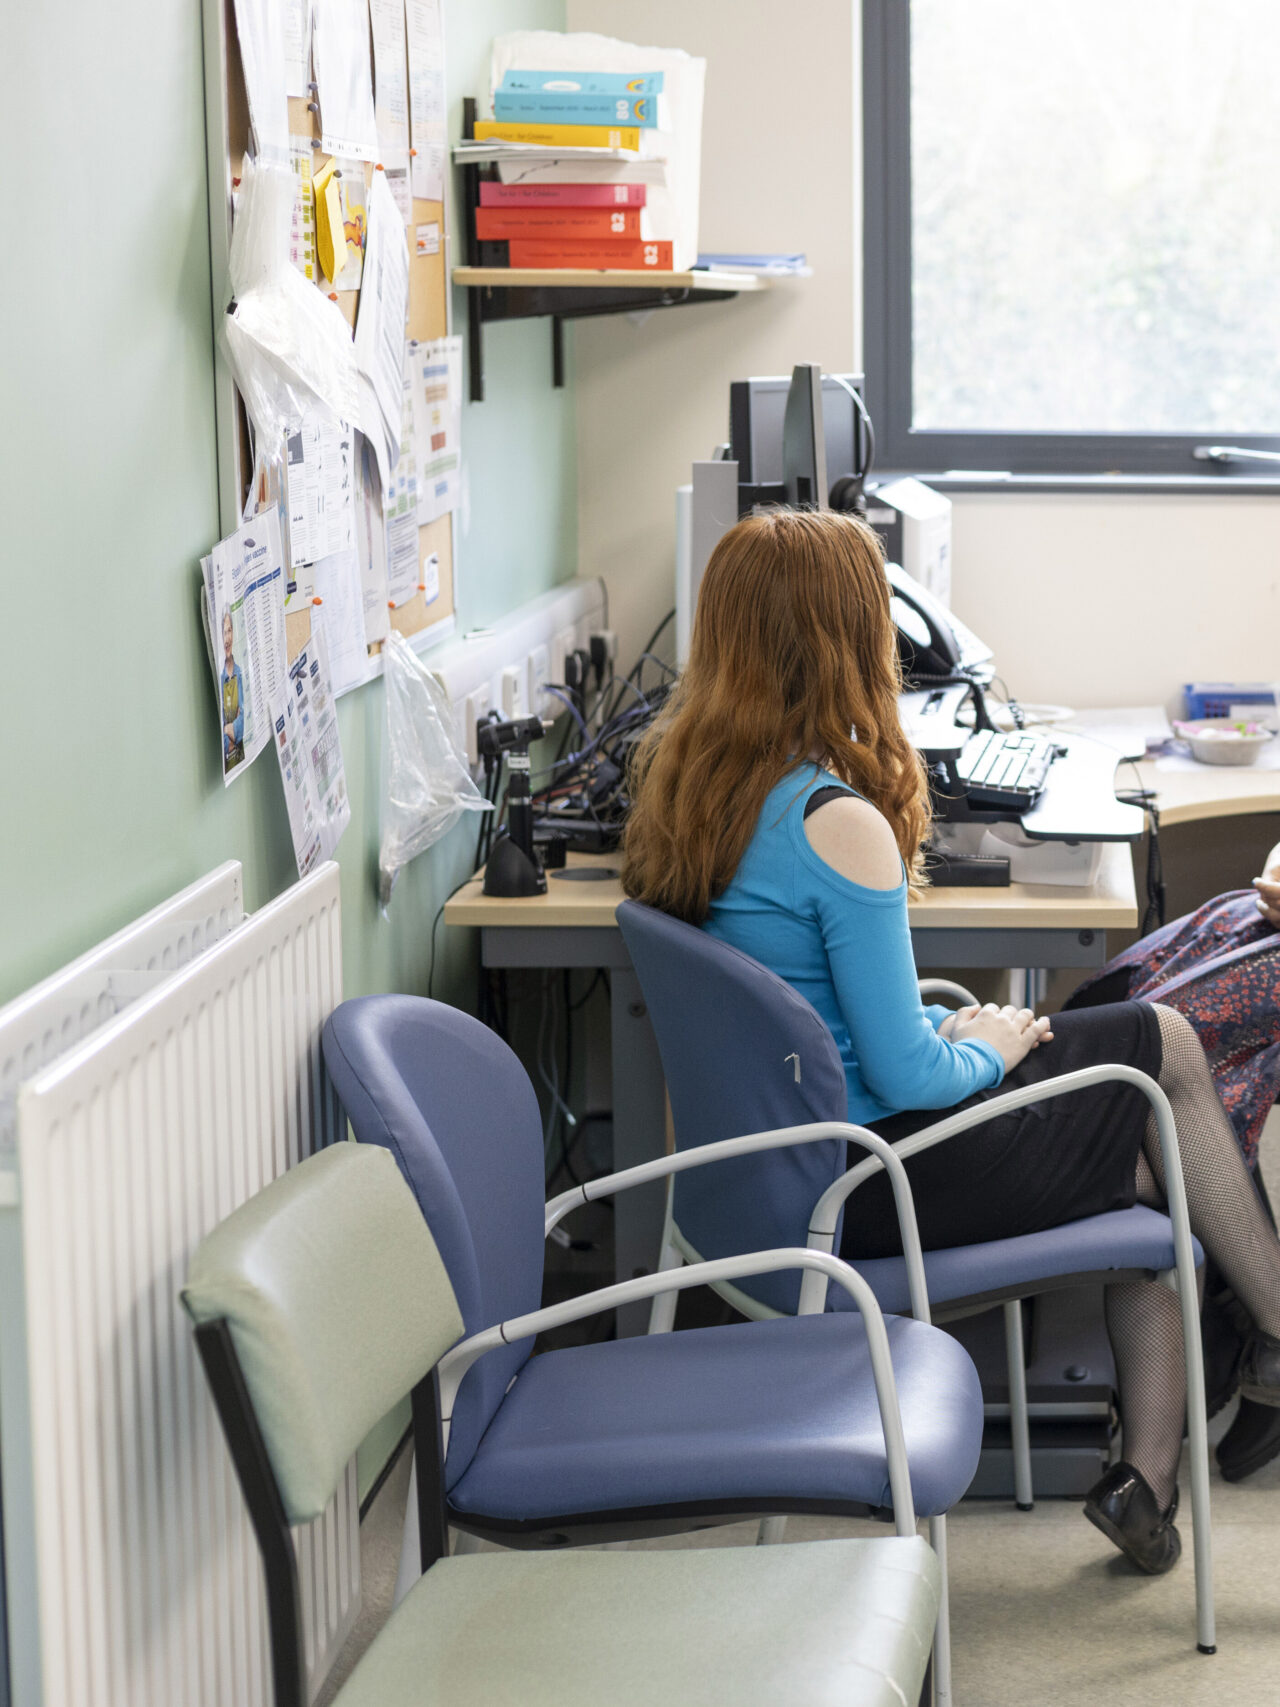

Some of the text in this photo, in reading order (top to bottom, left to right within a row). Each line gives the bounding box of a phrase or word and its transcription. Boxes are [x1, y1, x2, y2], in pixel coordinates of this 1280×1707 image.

[616, 100, 629, 120] 80
[611, 212, 625, 232] 82
[644, 245, 658, 265] 82
